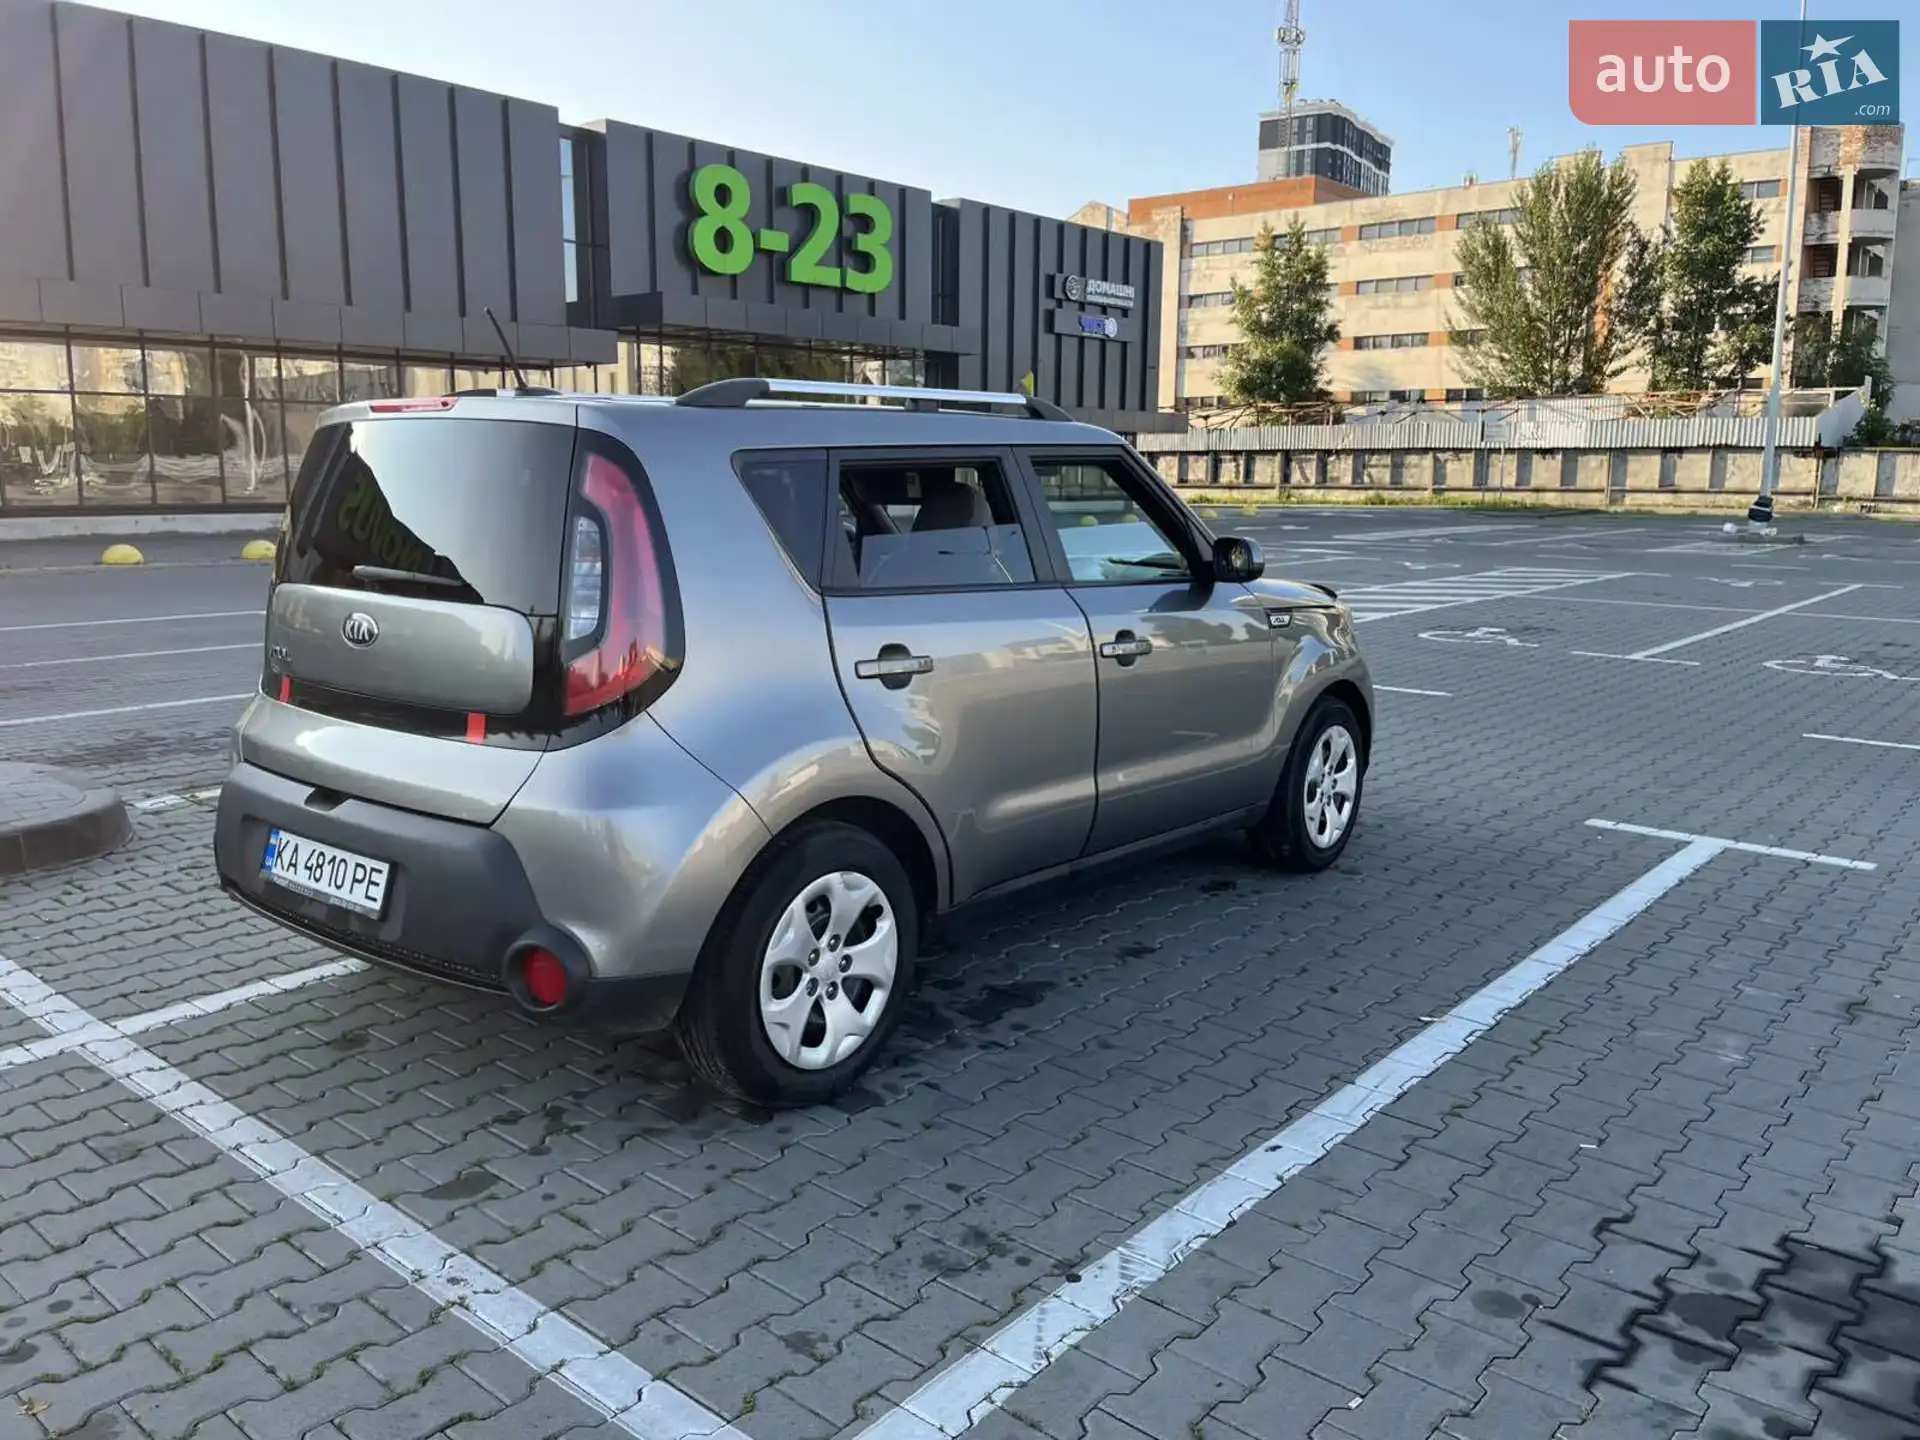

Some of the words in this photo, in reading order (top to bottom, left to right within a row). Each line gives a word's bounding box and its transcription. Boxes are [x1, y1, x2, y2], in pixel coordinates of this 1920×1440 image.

[688, 163, 893, 294] 8-23
[345, 618, 370, 641] KIA
[274, 837, 299, 876] KA
[304, 848, 348, 890] 4810
[349, 862, 384, 902] PE
